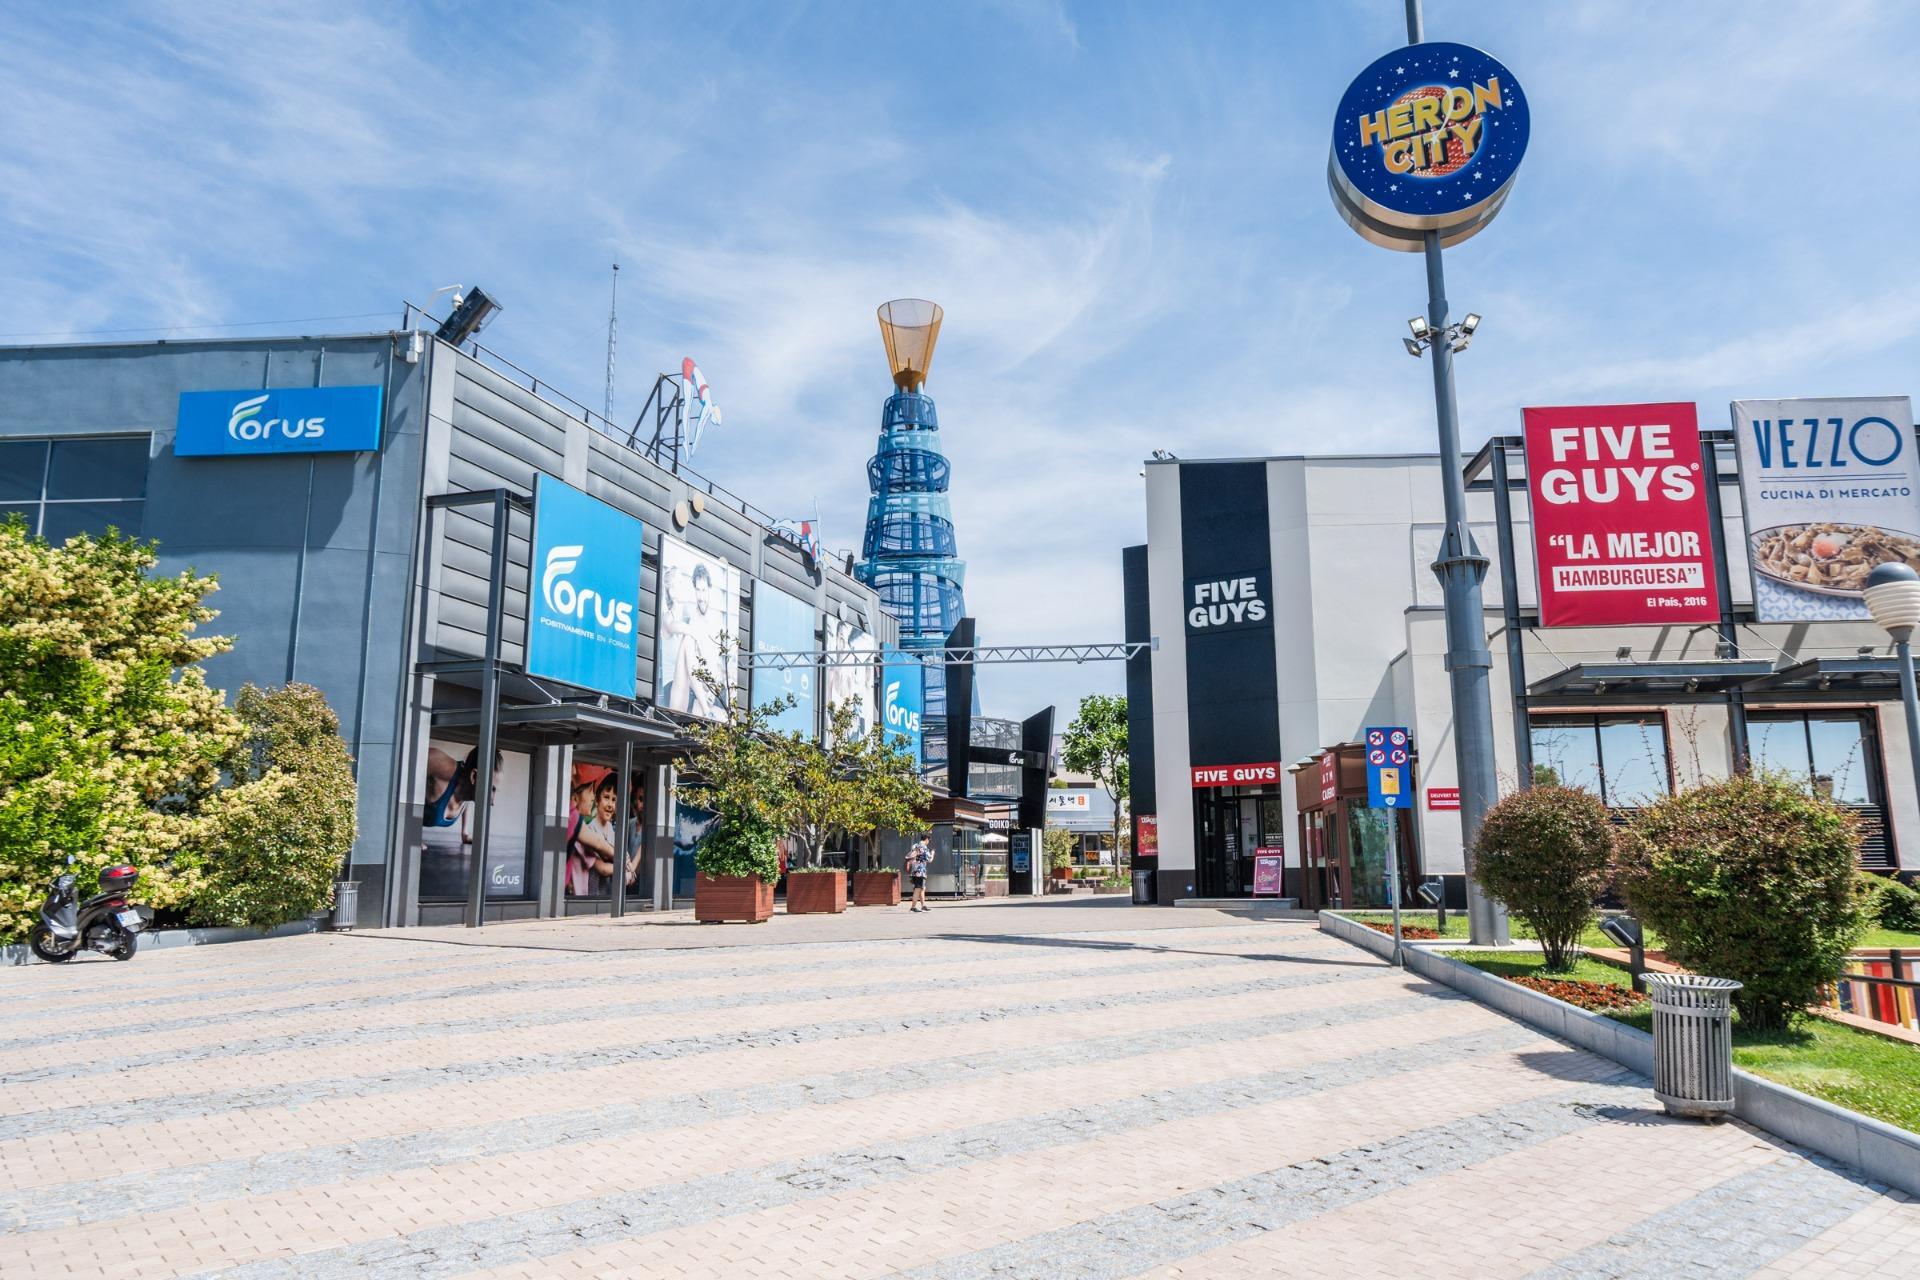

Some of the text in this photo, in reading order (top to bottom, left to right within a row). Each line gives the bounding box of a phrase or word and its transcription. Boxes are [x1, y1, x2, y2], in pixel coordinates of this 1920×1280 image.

[1359, 76, 1502, 148] HERON
[1384, 117, 1484, 174] CITY
[1550, 424, 1674, 462] FIVE
[1752, 416, 1903, 468] VEZZO
[1760, 488, 1910, 500] CUCINA DI MERCATO
[1607, 532, 1701, 559] MEJOR
[1194, 577, 1258, 604] FIVE
[1646, 598, 1656, 607] El
[1684, 596, 1708, 606] 2016
[1188, 600, 1266, 628] GUYS
[540, 616, 630, 650] POSITIVAMENTE EN FORMA
[1195, 767, 1276, 782] FIVE GUYS
[989, 820, 1010, 829] GOIKO
